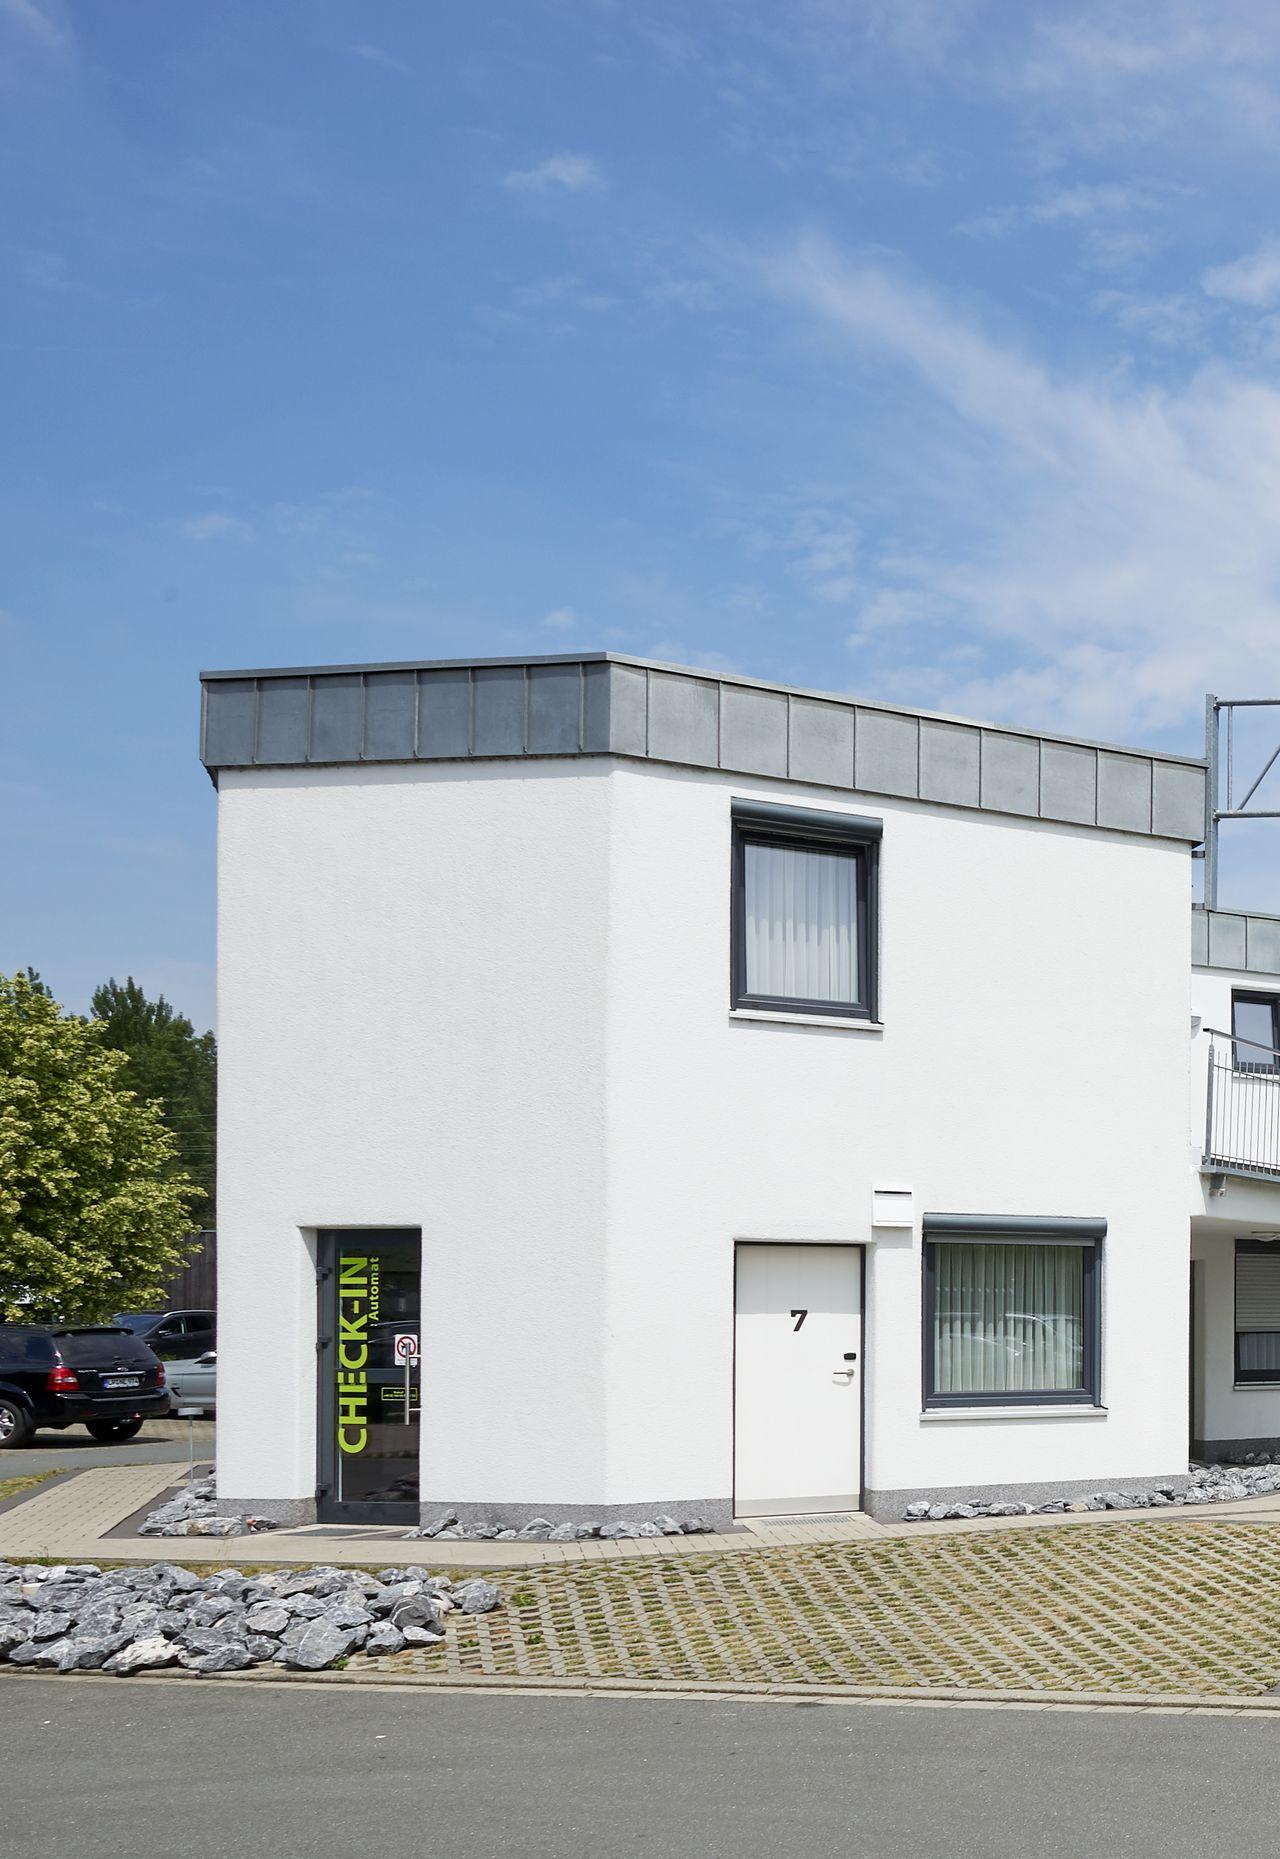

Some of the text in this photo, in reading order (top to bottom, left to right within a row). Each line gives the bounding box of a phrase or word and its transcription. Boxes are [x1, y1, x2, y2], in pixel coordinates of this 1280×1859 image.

[368, 1257, 380, 1321] Automat
[790, 1309, 808, 1332] 7
[337, 1257, 368, 1454] CHECK-IN
